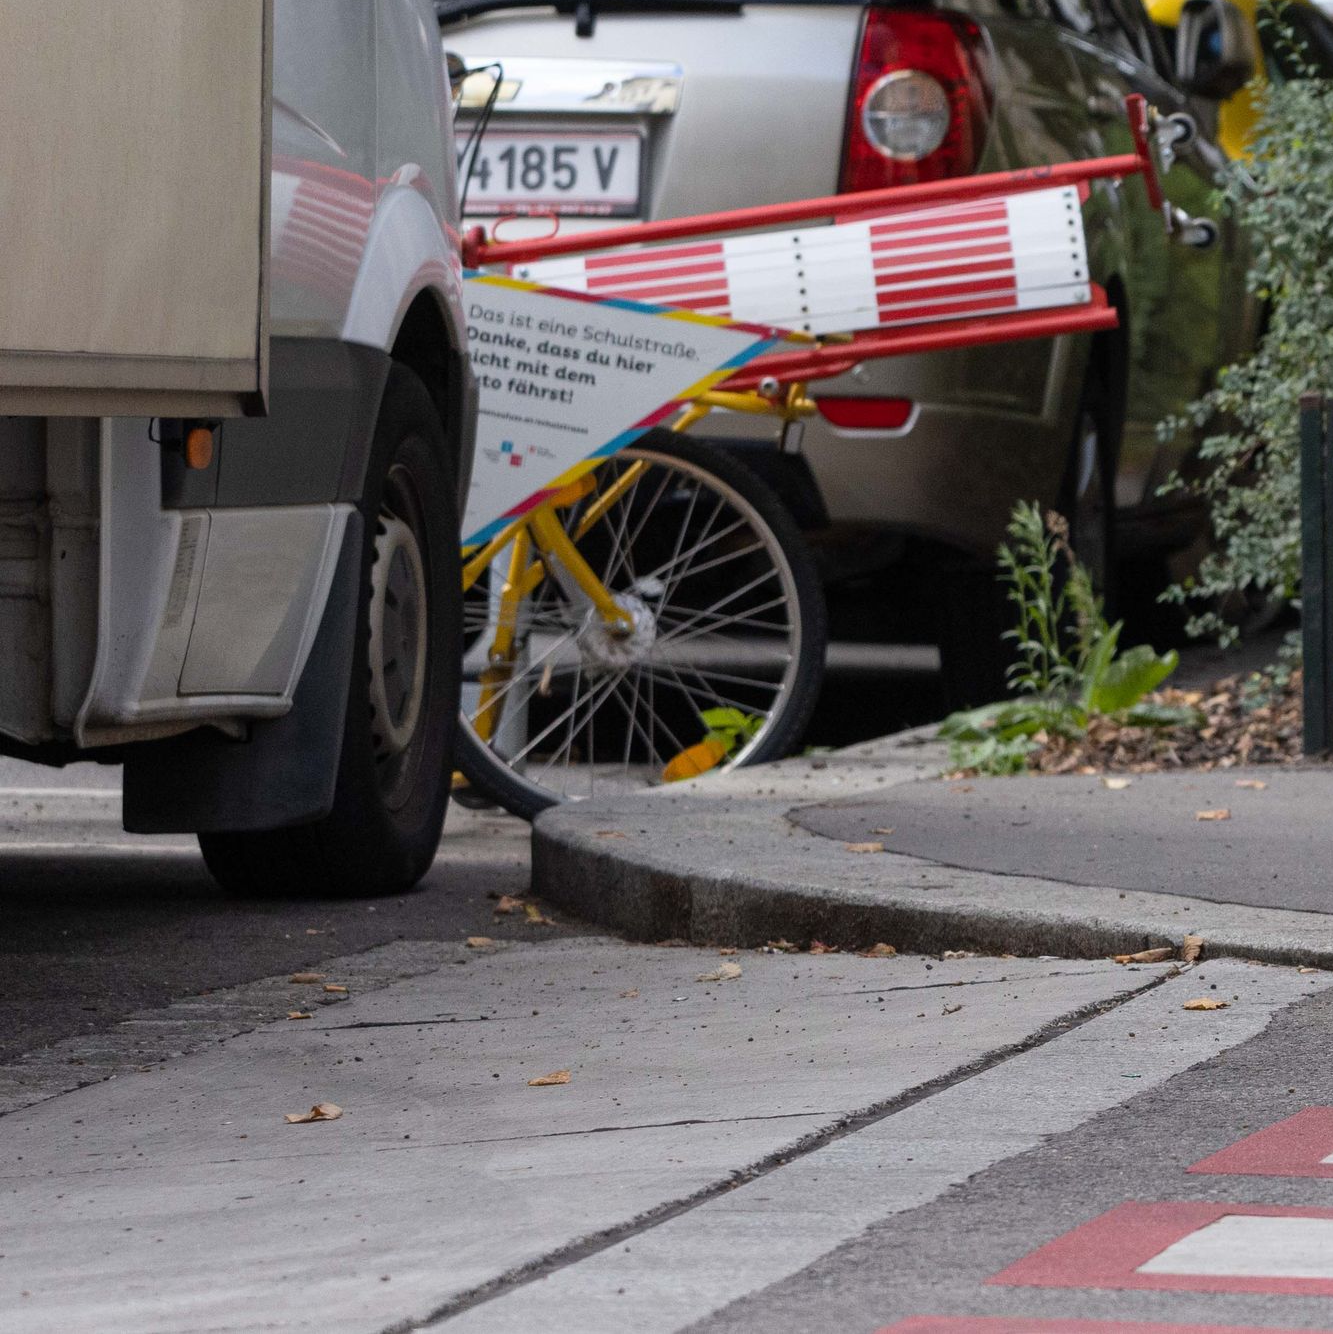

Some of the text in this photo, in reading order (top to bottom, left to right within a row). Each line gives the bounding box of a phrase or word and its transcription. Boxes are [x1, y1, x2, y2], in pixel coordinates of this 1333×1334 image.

[459, 145, 619, 190] 4185 V
[467, 326, 656, 374] Danke, dass du hier
[469, 304, 700, 361] Das ist eine Schulstraße.
[508, 380, 573, 404] fährst!
[516, 359, 548, 377] mit
[555, 365, 596, 385] dem
